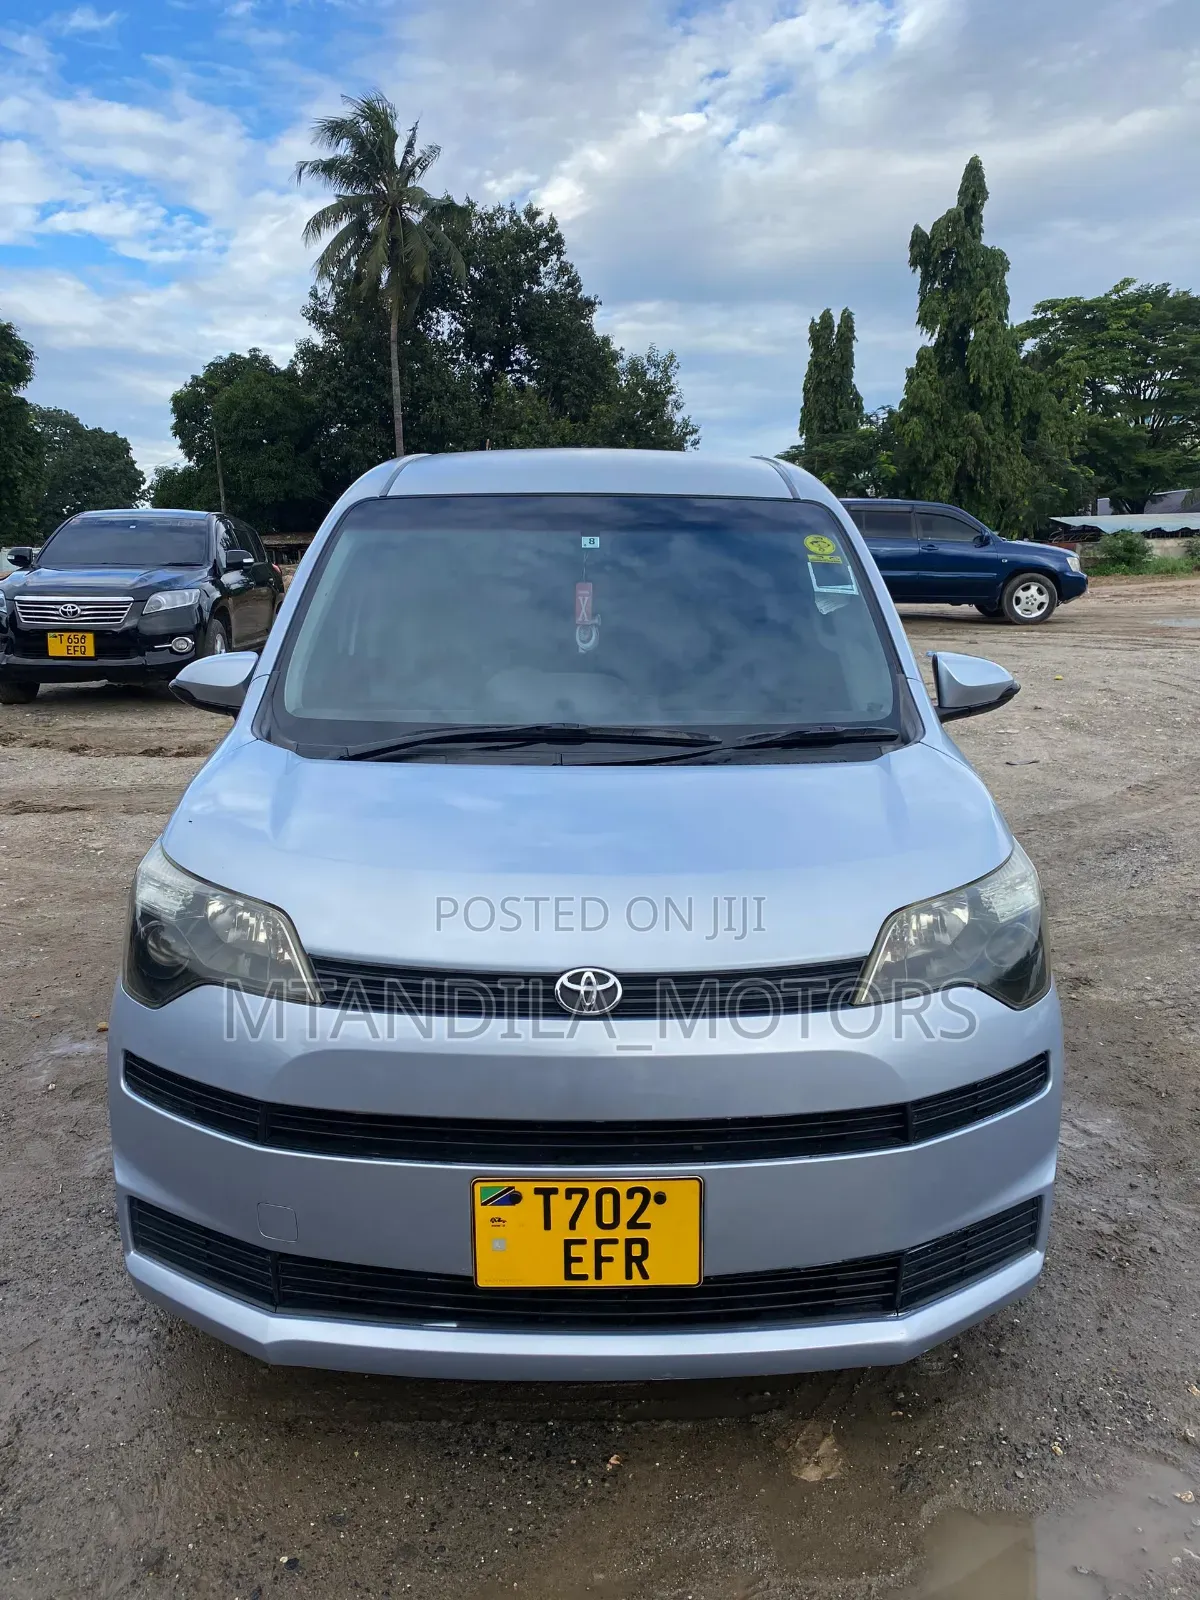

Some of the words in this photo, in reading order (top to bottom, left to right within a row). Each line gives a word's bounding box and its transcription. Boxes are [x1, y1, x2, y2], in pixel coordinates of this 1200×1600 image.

[58, 634, 64, 644] T
[66, 645, 86, 655] EFQ
[533, 1186, 652, 1231] T702
[563, 1237, 650, 1281] EFR
